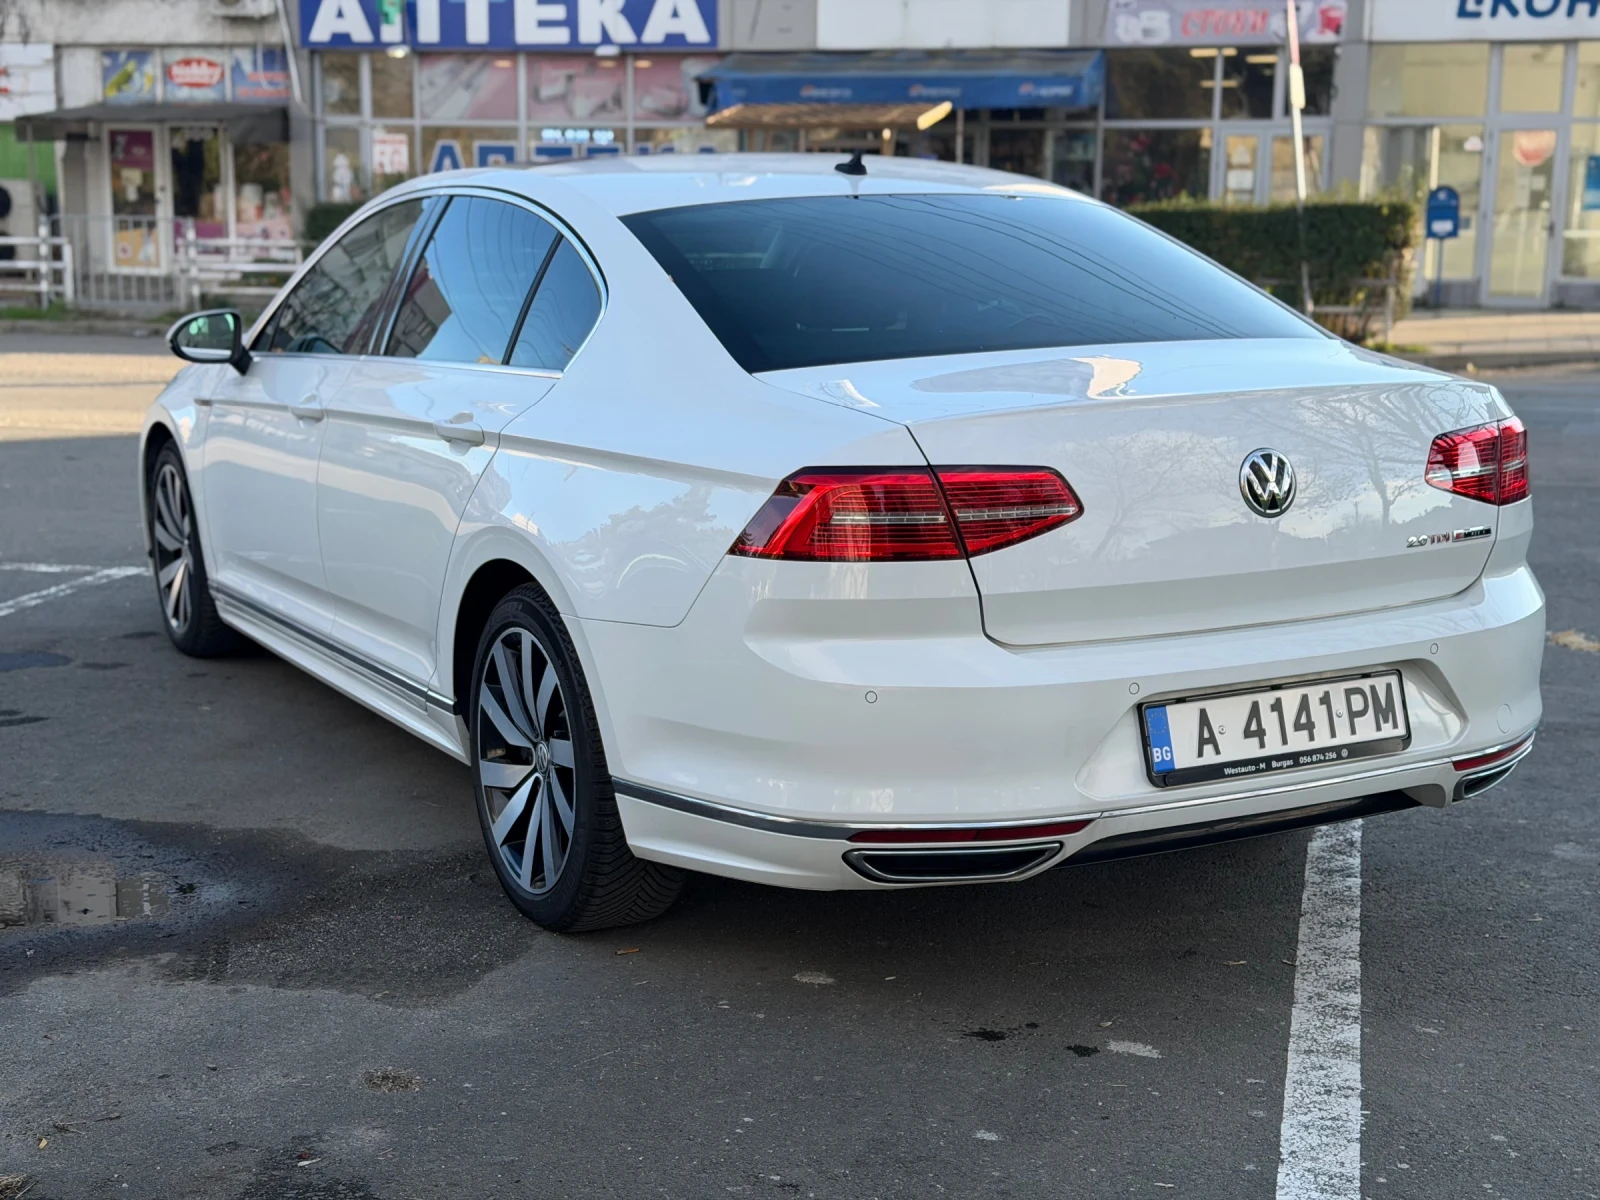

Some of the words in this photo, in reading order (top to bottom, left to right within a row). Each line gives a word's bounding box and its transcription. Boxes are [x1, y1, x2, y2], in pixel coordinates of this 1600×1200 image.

[1197, 707, 1222, 759] A
[1243, 690, 1337, 750] 4141
[1343, 682, 1399, 736] PM
[1153, 746, 1172, 763] BG
[1271, 758, 1294, 769] Burgas
[1299, 755, 1312, 764] 056
[1312, 753, 1325, 762] 874
[1325, 751, 1338, 760] 256
